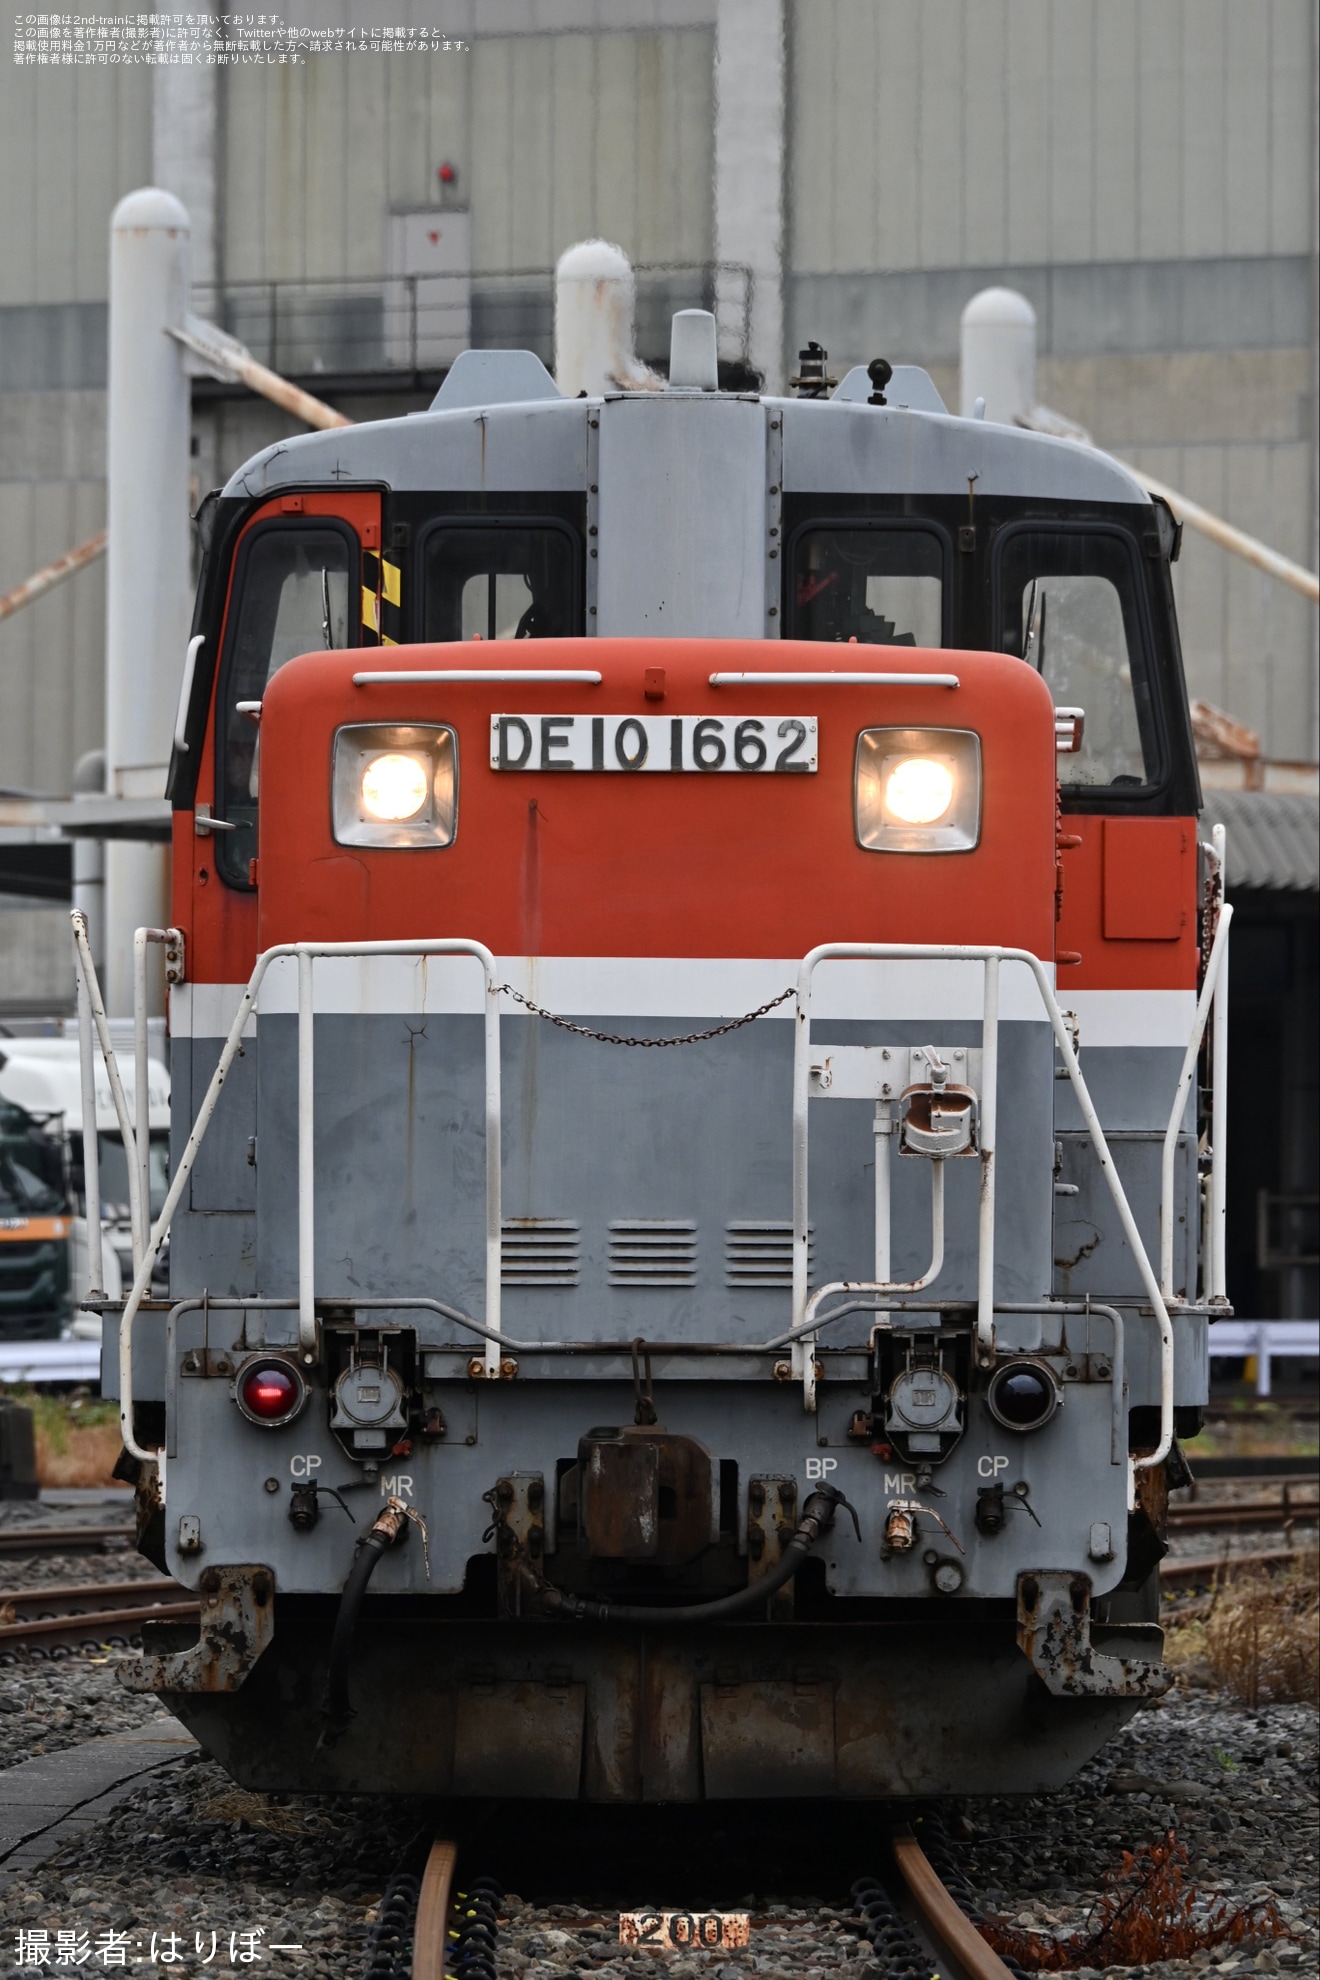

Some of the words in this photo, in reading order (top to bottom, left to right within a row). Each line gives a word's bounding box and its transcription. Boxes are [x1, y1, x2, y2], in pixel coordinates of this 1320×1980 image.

[498, 717, 650, 771] DE10
[670, 718, 810, 772] 1662
[290, 1455, 322, 1476] CP
[806, 1458, 838, 1479] BP
[977, 1456, 1009, 1477] CP
[381, 1475, 414, 1496] MR
[884, 1473, 917, 1494] MR
[637, 1913, 723, 1948] 200
